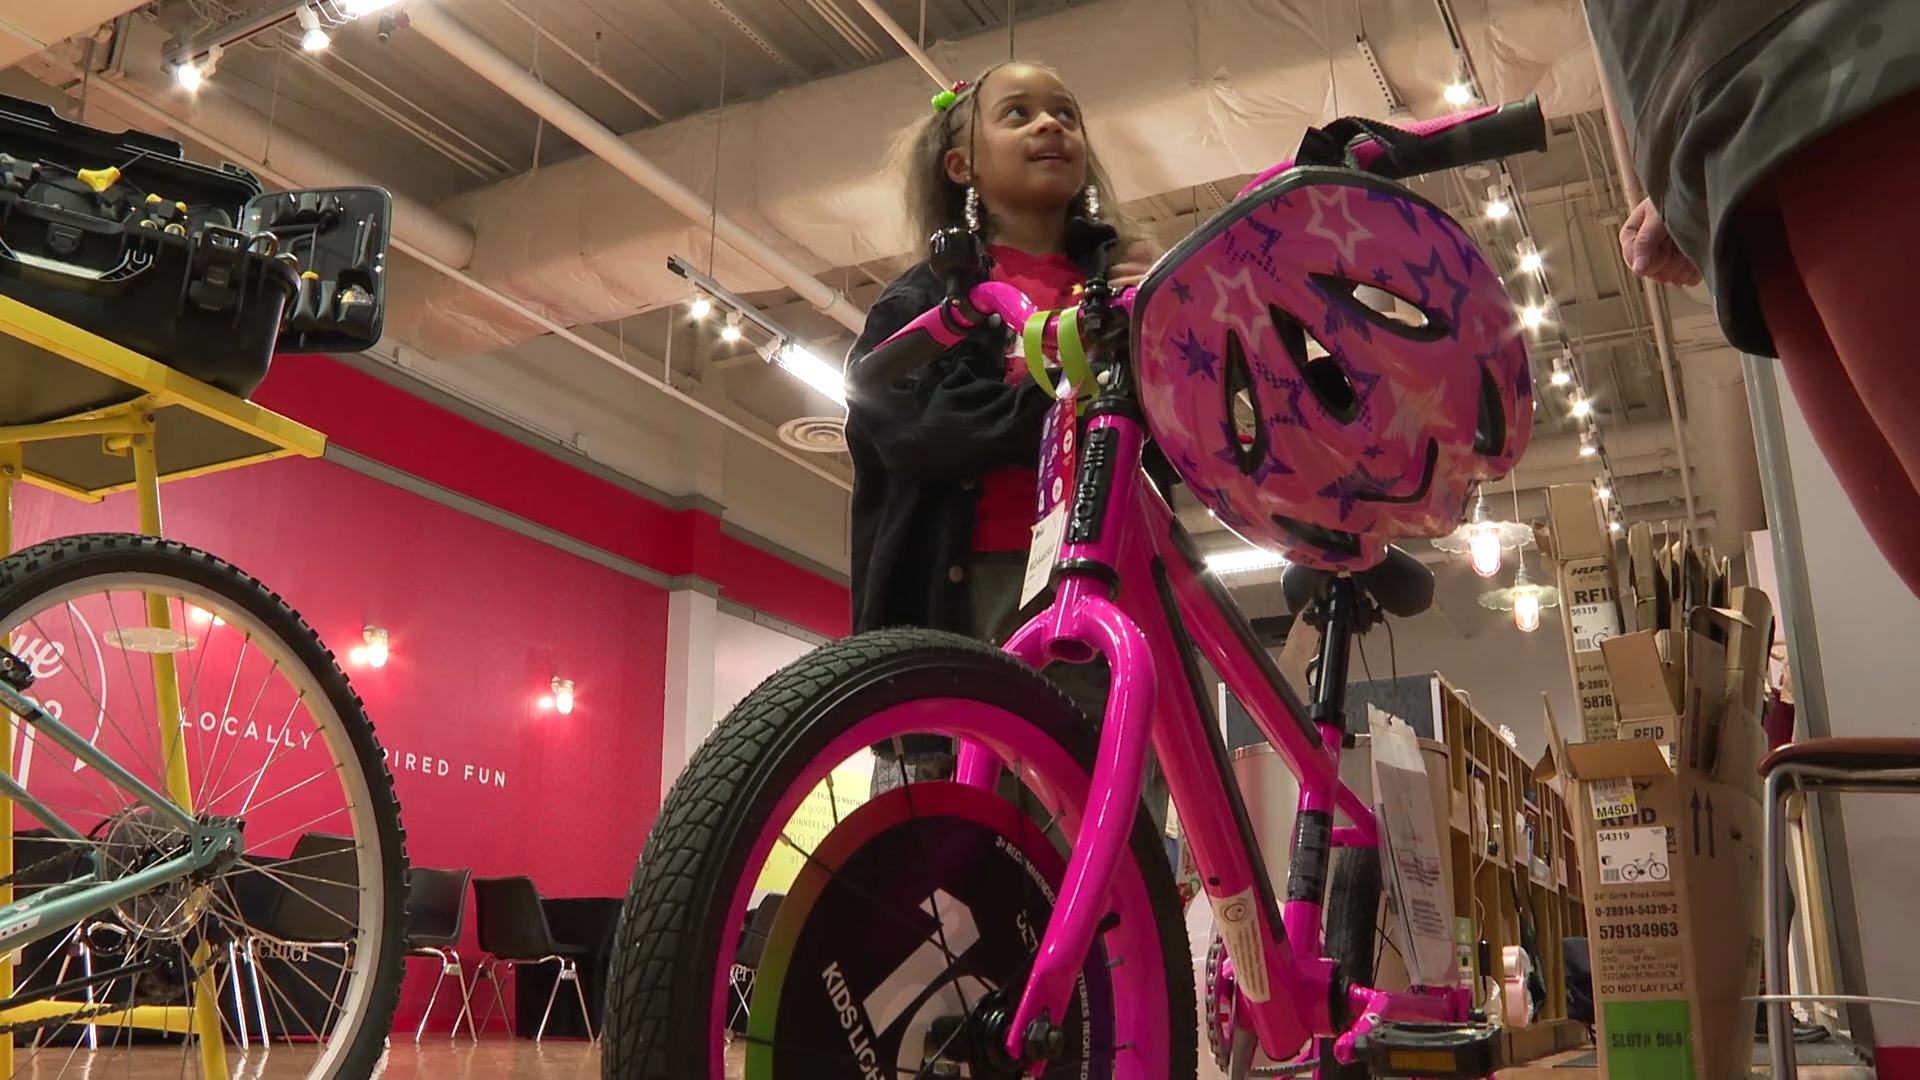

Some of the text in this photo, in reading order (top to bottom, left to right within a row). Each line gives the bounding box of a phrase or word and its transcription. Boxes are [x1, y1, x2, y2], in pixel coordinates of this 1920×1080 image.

[179, 707, 313, 750] LOCALLY
[464, 764, 506, 787] FUN
[1596, 803, 1635, 818] M4501
[1599, 832, 1630, 842] 54319
[1599, 921, 1679, 940] 579134963
[822, 961, 858, 1029] KIDS
[1601, 982, 1685, 994] DO NOT LAY FLAT
